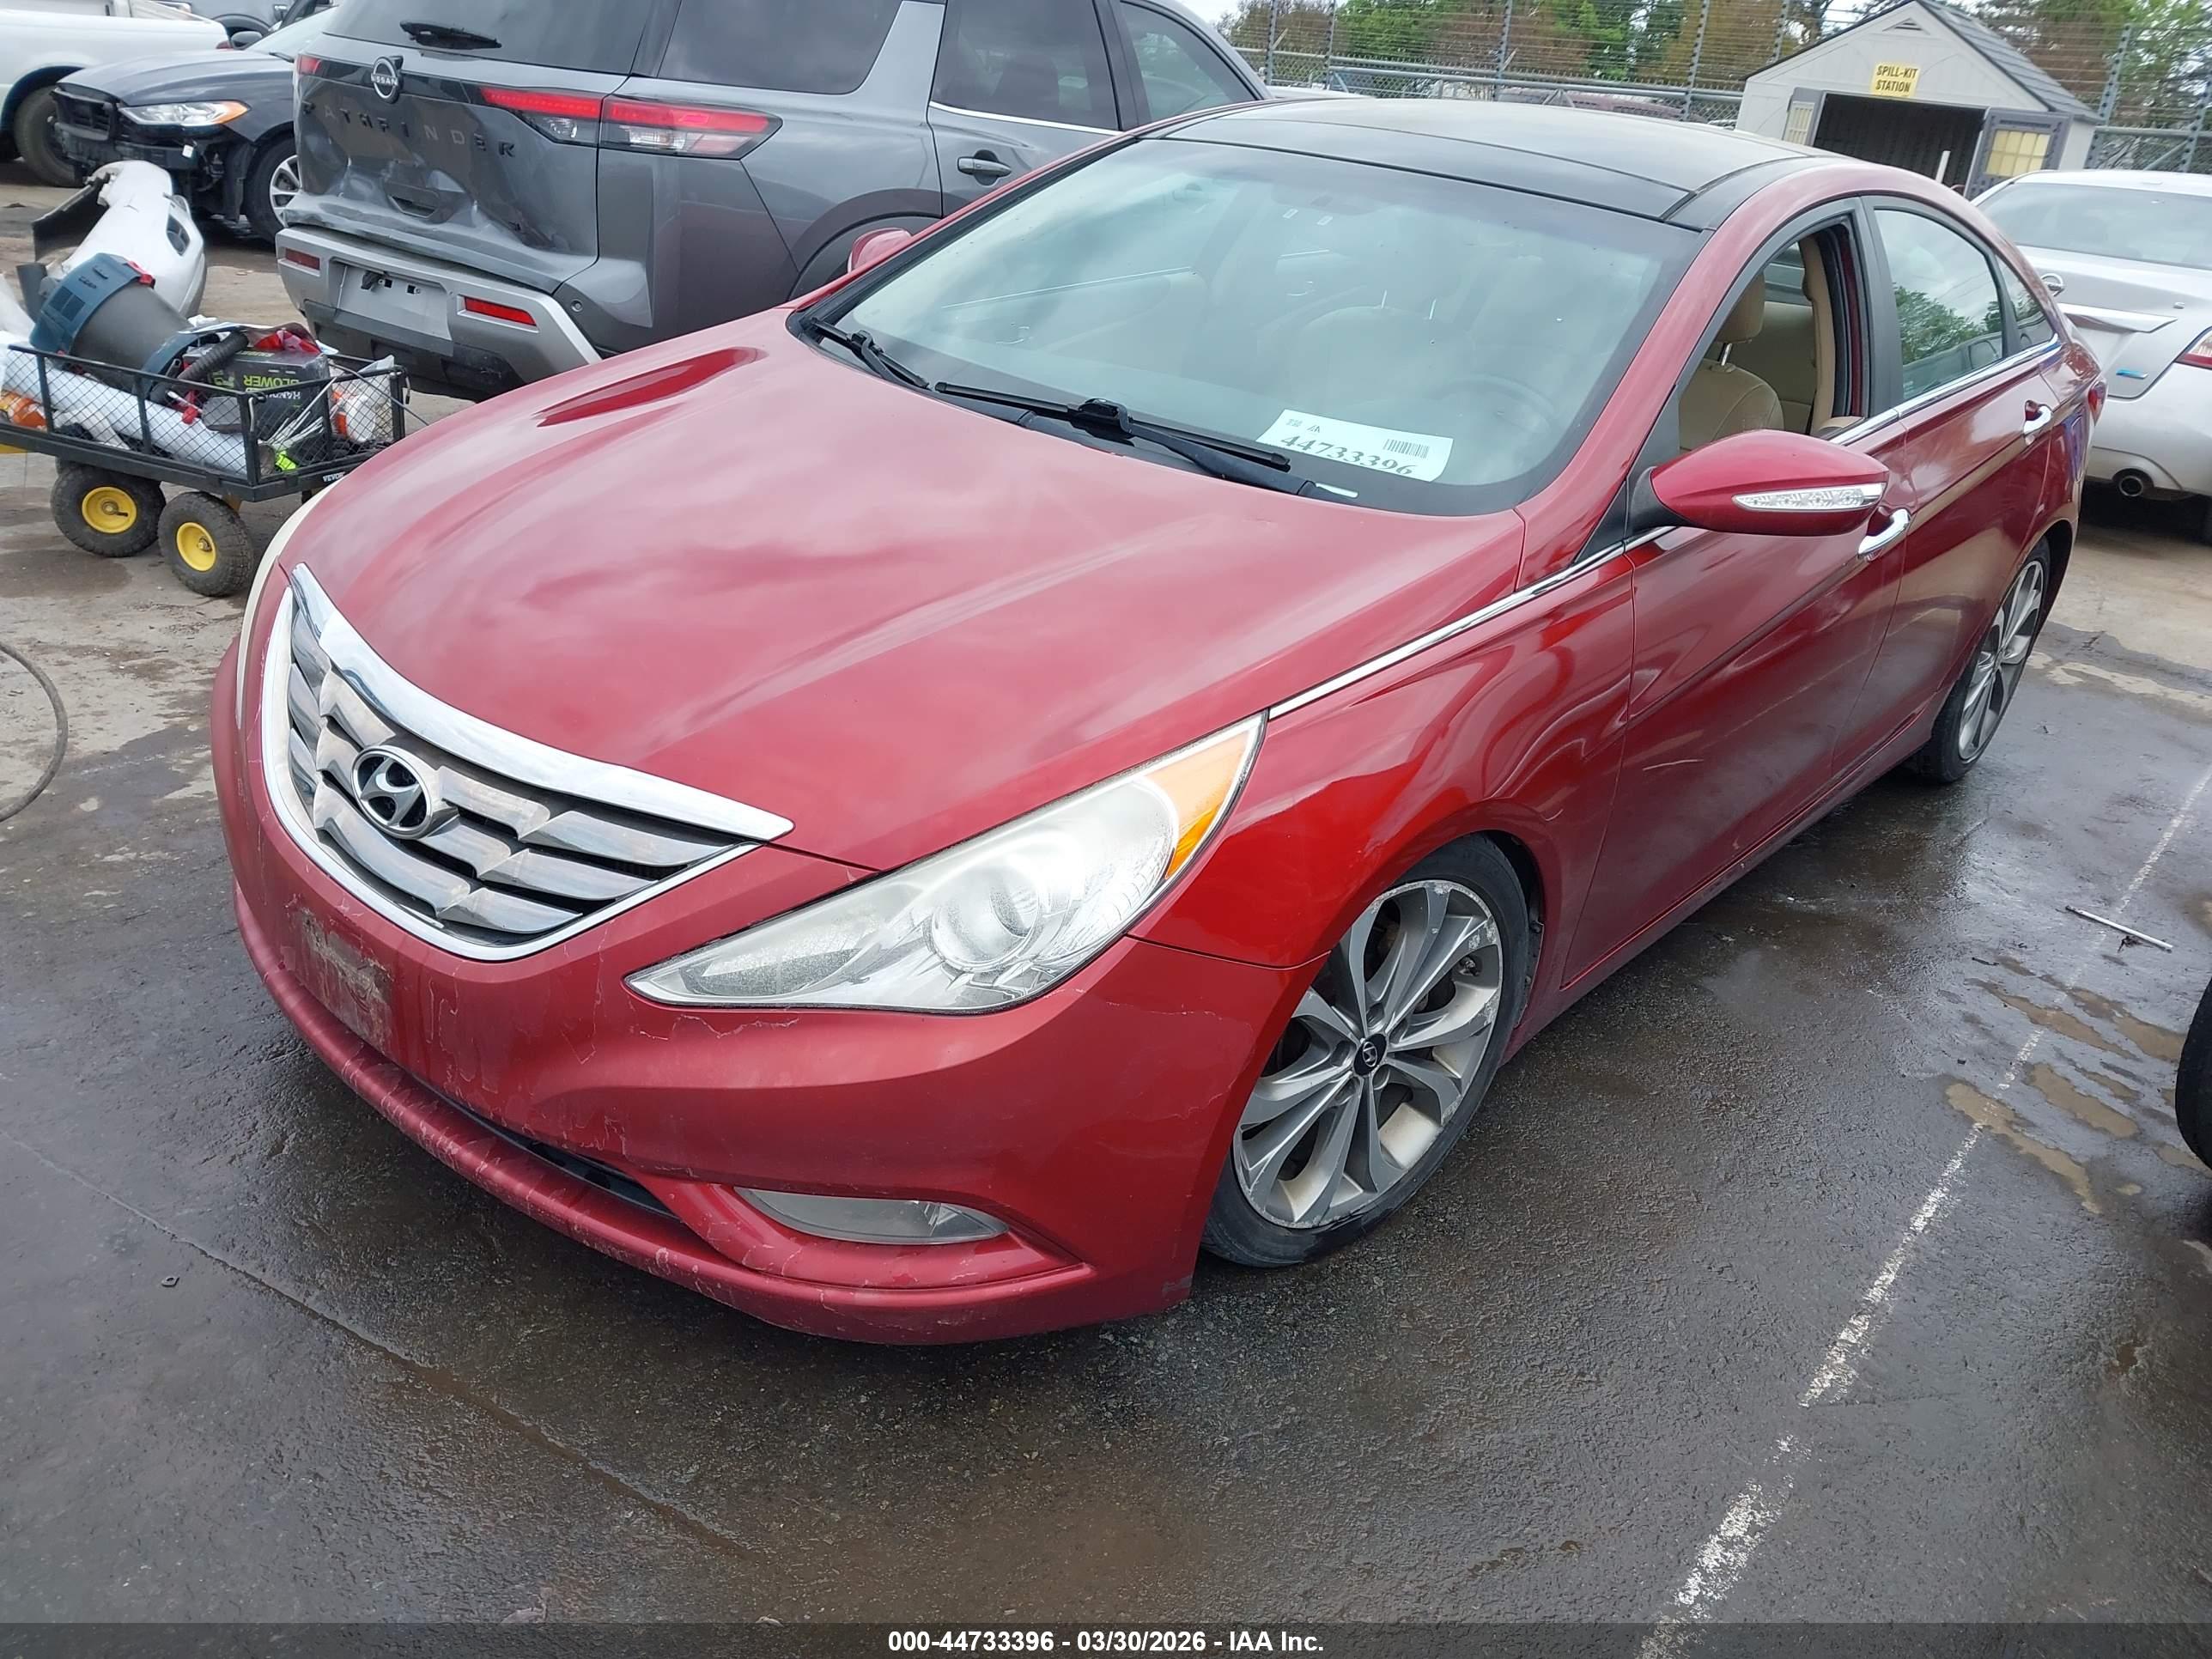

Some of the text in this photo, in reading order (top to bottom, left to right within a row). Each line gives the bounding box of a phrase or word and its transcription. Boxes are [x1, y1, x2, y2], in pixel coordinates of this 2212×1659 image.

[1876, 65, 1918, 78] SPILL-KIT
[371, 73, 398, 86] NISSAN
[1875, 80, 1911, 92] STATION
[1281, 435, 1418, 475] 44733396
